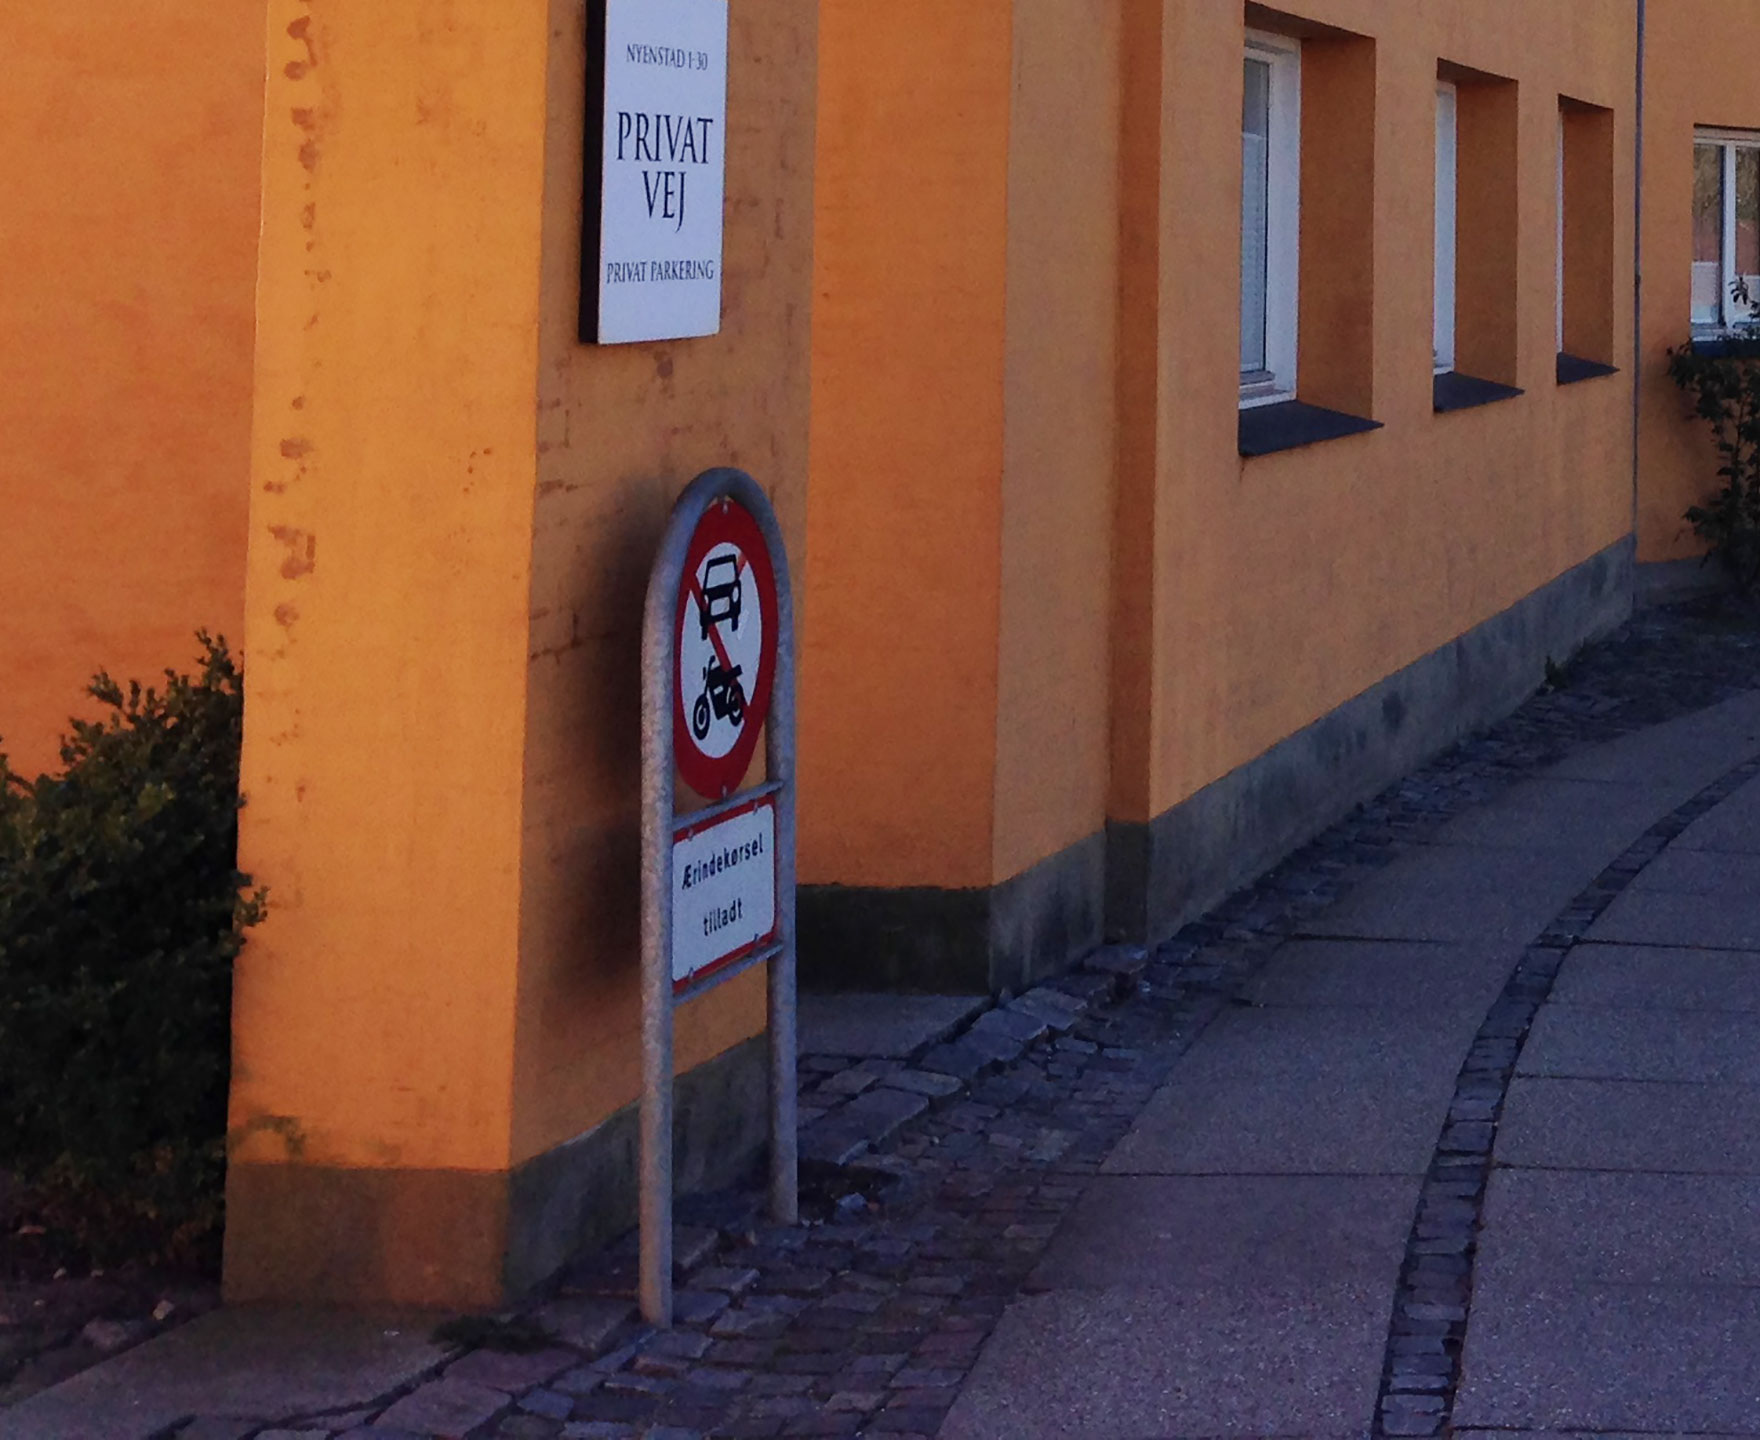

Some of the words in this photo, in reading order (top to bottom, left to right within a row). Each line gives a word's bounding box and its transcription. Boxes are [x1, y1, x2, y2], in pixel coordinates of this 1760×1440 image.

[616, 111, 714, 165] PRIVAT
[642, 170, 688, 233] VEJ
[606, 261, 647, 284] PRIVAT
[650, 259, 715, 282] PARKERING
[681, 833, 764, 890] Ærindekørsel
[703, 898, 743, 936] tilladt
